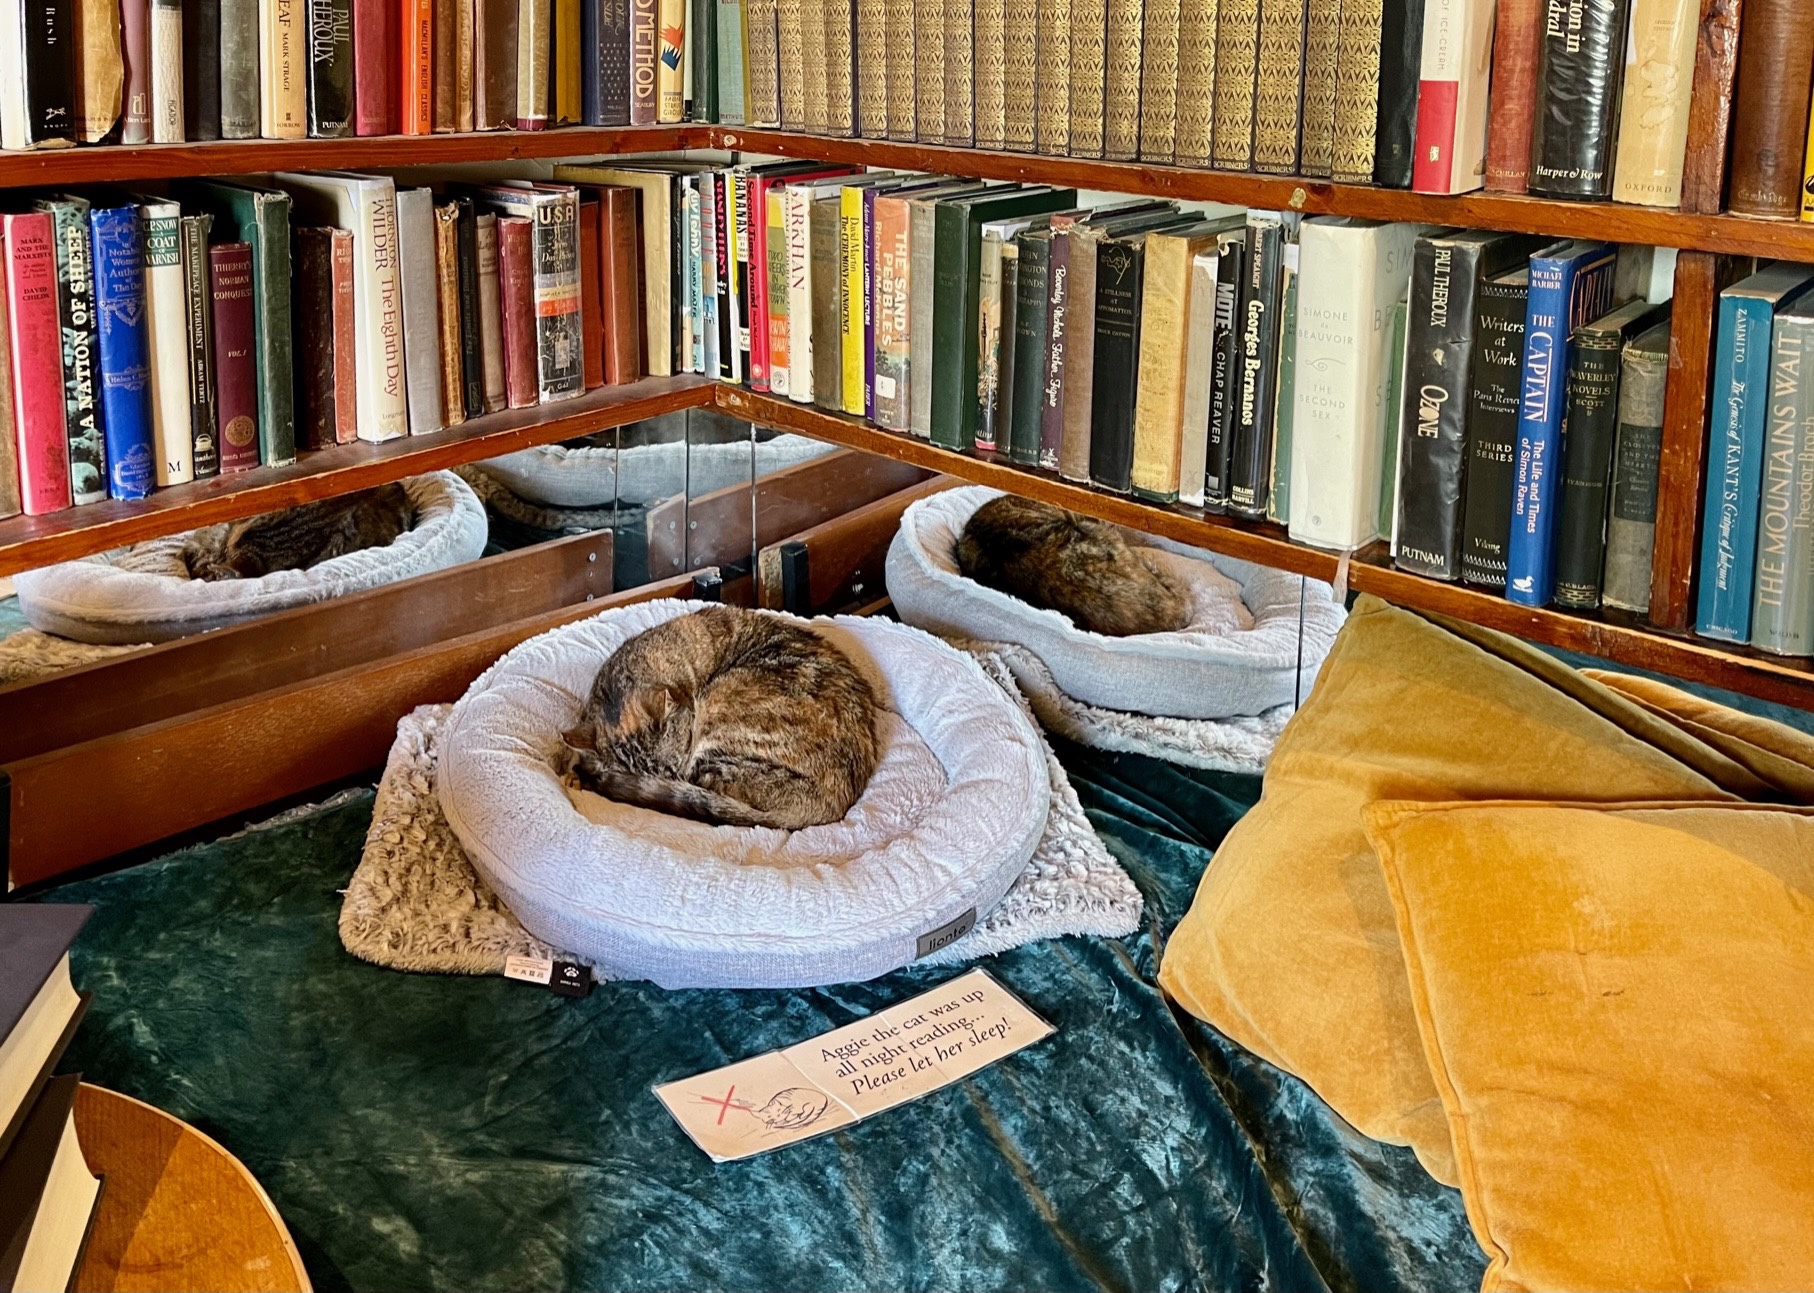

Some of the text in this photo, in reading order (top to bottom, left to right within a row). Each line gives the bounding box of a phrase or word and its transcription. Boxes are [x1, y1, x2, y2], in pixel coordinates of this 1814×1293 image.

[333, 8, 349, 45] PAUL
[282, 32, 290, 58] MARK
[420, 19, 428, 61] MACMILLAN'S
[1566, 33, 1586, 53] in
[635, 12, 656, 98] METHOD
[420, 93, 428, 122] CLASSICS
[1536, 165, 1568, 179] Harper
[1580, 169, 1603, 180] Row
[1625, 182, 1672, 194] OXFORD
[736, 174, 747, 234] BANANAS
[747, 180, 756, 228] Second
[147, 236, 176, 248] COAT
[372, 199, 388, 271] WILDER
[386, 198, 397, 269] THORNTON
[850, 217, 860, 272] David Martin
[111, 258, 140, 266] Women
[146, 253, 178, 265] VARNISH
[214, 262, 252, 272] THIERRY'S
[768, 250, 783, 261] TWO
[219, 275, 250, 286] NORMAN
[841, 216, 850, 336] The CEREMONY of INNOCENCE
[874, 221, 883, 335] Richard McKenna
[894, 230, 907, 331] THE SAND
[1252, 253, 1262, 289] SPEAIGHT
[1532, 270, 1562, 280] MICHAEL
[22, 293, 50, 301] CHILDS
[24, 286, 47, 294] DAVID
[113, 284, 129, 292] The
[749, 263, 758, 308] Around
[1051, 264, 1067, 305] Beverley
[1104, 288, 1132, 298] STILLNESS
[1430, 249, 1451, 328] PAUL THEROUX
[1532, 280, 1561, 290] BARBER
[882, 252, 894, 346] PEBBLES
[1216, 282, 1235, 330] MOTE
[67, 225, 94, 429] A NATION OF SHEEP
[193, 295, 204, 349] EXPERIMENT
[1053, 306, 1065, 341] Nichols
[1304, 308, 1348, 321] SIMONE
[1480, 315, 1525, 334] Writers
[381, 276, 400, 397] The Eighth Day
[1299, 329, 1353, 345] BEAUVOIR
[1494, 337, 1506, 347] at
[1735, 308, 1748, 363] ZAMMITO
[1051, 343, 1064, 379] Father
[1242, 300, 1264, 426] Georges Bernanos
[1484, 349, 1517, 367] Work
[1524, 314, 1556, 423] THE CAPTAIN
[1583, 361, 1605, 370] THE
[1775, 331, 1801, 399] WAIT
[1491, 384, 1505, 394] The
[1571, 370, 1616, 382] WAVERLEY
[1211, 352, 1226, 444] CHAP REAVER
[1300, 394, 1345, 409] SECOND
[1314, 385, 1331, 394] THE
[1474, 390, 1493, 403] Paris
[1572, 385, 1611, 396] NOVELS
[1732, 380, 1746, 402] The
[1312, 410, 1331, 420] SEX
[1576, 399, 1605, 408] SCOTT
[1728, 398, 1745, 429] Genesis
[1478, 440, 1513, 453] THIRD
[1727, 430, 1741, 441] of
[168, 461, 181, 473] M
[1476, 449, 1513, 463] SERIES
[1516, 438, 1531, 515] of Simon Raven
[1567, 479, 1602, 488] IVANHOE
[1725, 442, 1742, 501] KANT'S
[1765, 406, 1798, 555] MOUNTAINS
[1793, 416, 1814, 530] Theodor Broch
[1232, 485, 1254, 495] COLLINS
[1527, 440, 1544, 534] The Life and Times
[1721, 503, 1739, 539] Critique
[1402, 545, 1445, 566] PUTNAM
[1475, 537, 1500, 554] Viking
[1718, 539, 1732, 550] of
[1759, 559, 1786, 608] THE
[1706, 623, 1738, 636] CHICAGO
[929, 925, 966, 951] lionto
[820, 988, 985, 1064] Aggie the cat was up
[835, 1013, 986, 1080] all night reading...
[851, 1016, 1013, 1097] Please let her sleep!
